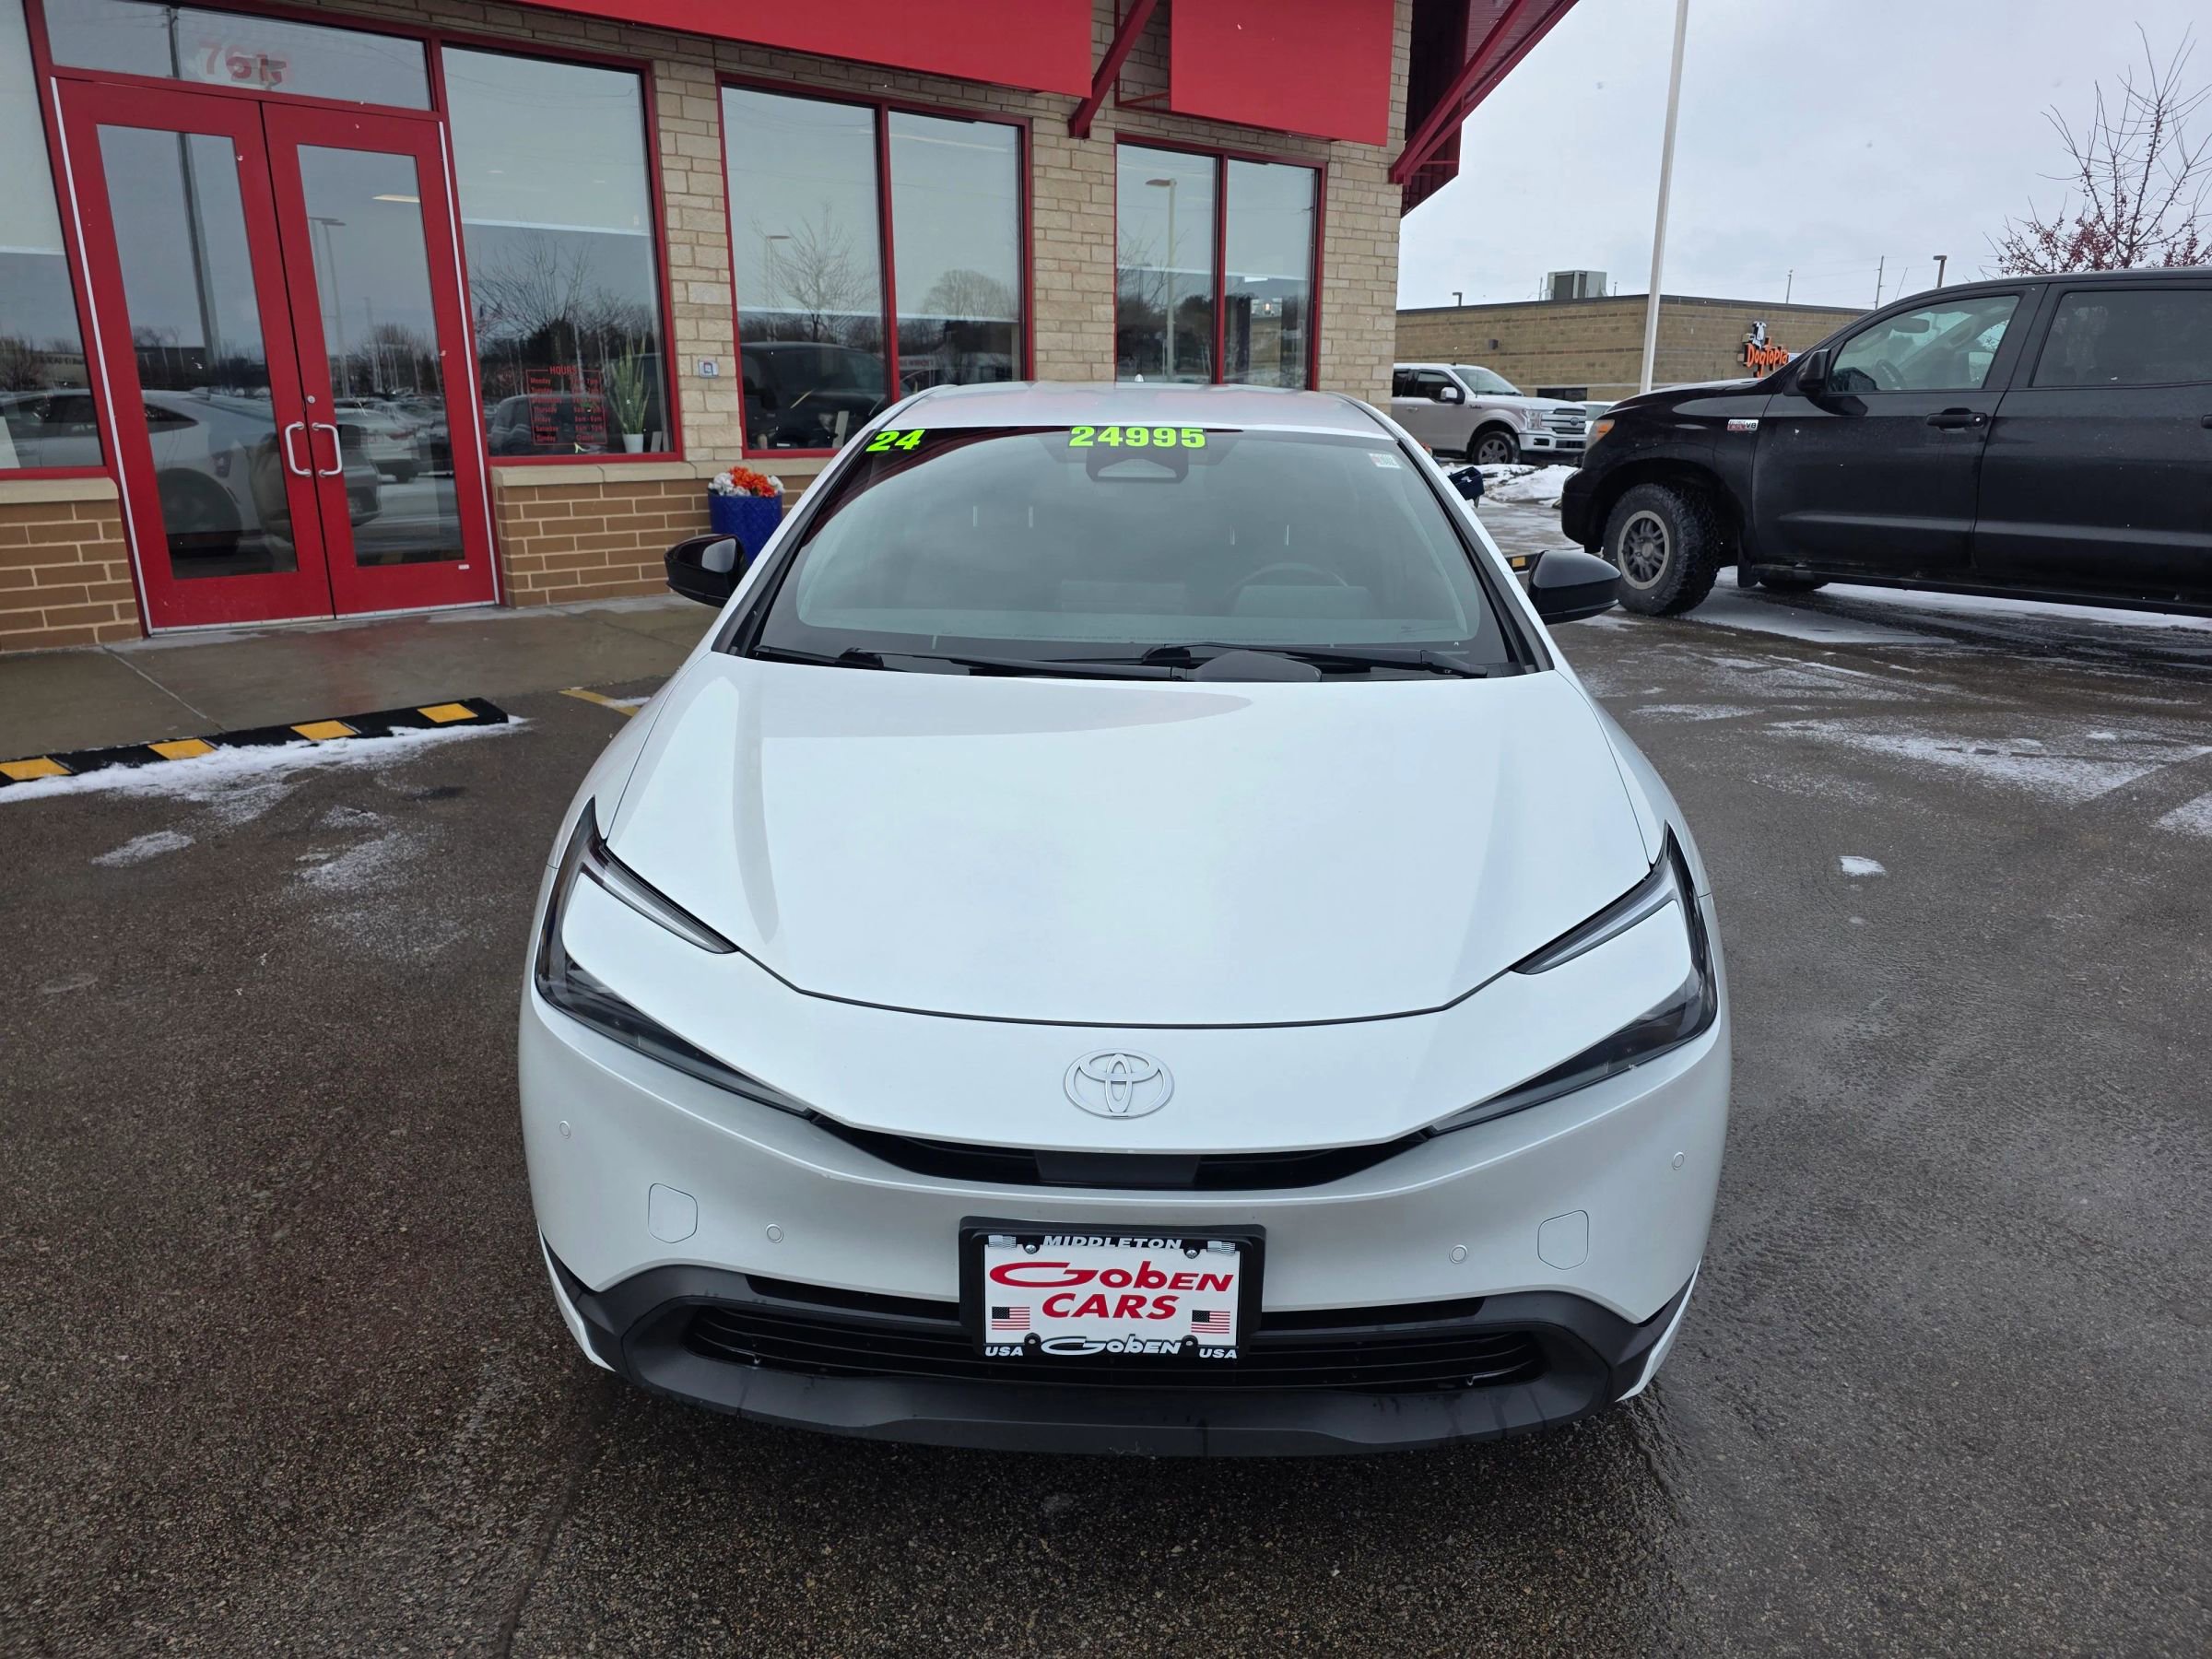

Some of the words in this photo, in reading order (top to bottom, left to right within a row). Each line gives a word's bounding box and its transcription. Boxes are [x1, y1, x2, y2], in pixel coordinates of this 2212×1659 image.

[549, 365, 576, 375] HOURS
[866, 429, 925, 452] 24
[1070, 426, 1205, 447] 24995
[1043, 1235, 1182, 1250] MIDDLETON
[1042, 1292, 1180, 1320] CARS
[984, 1347, 1024, 1357] USA
[1199, 1348, 1238, 1359] USA
